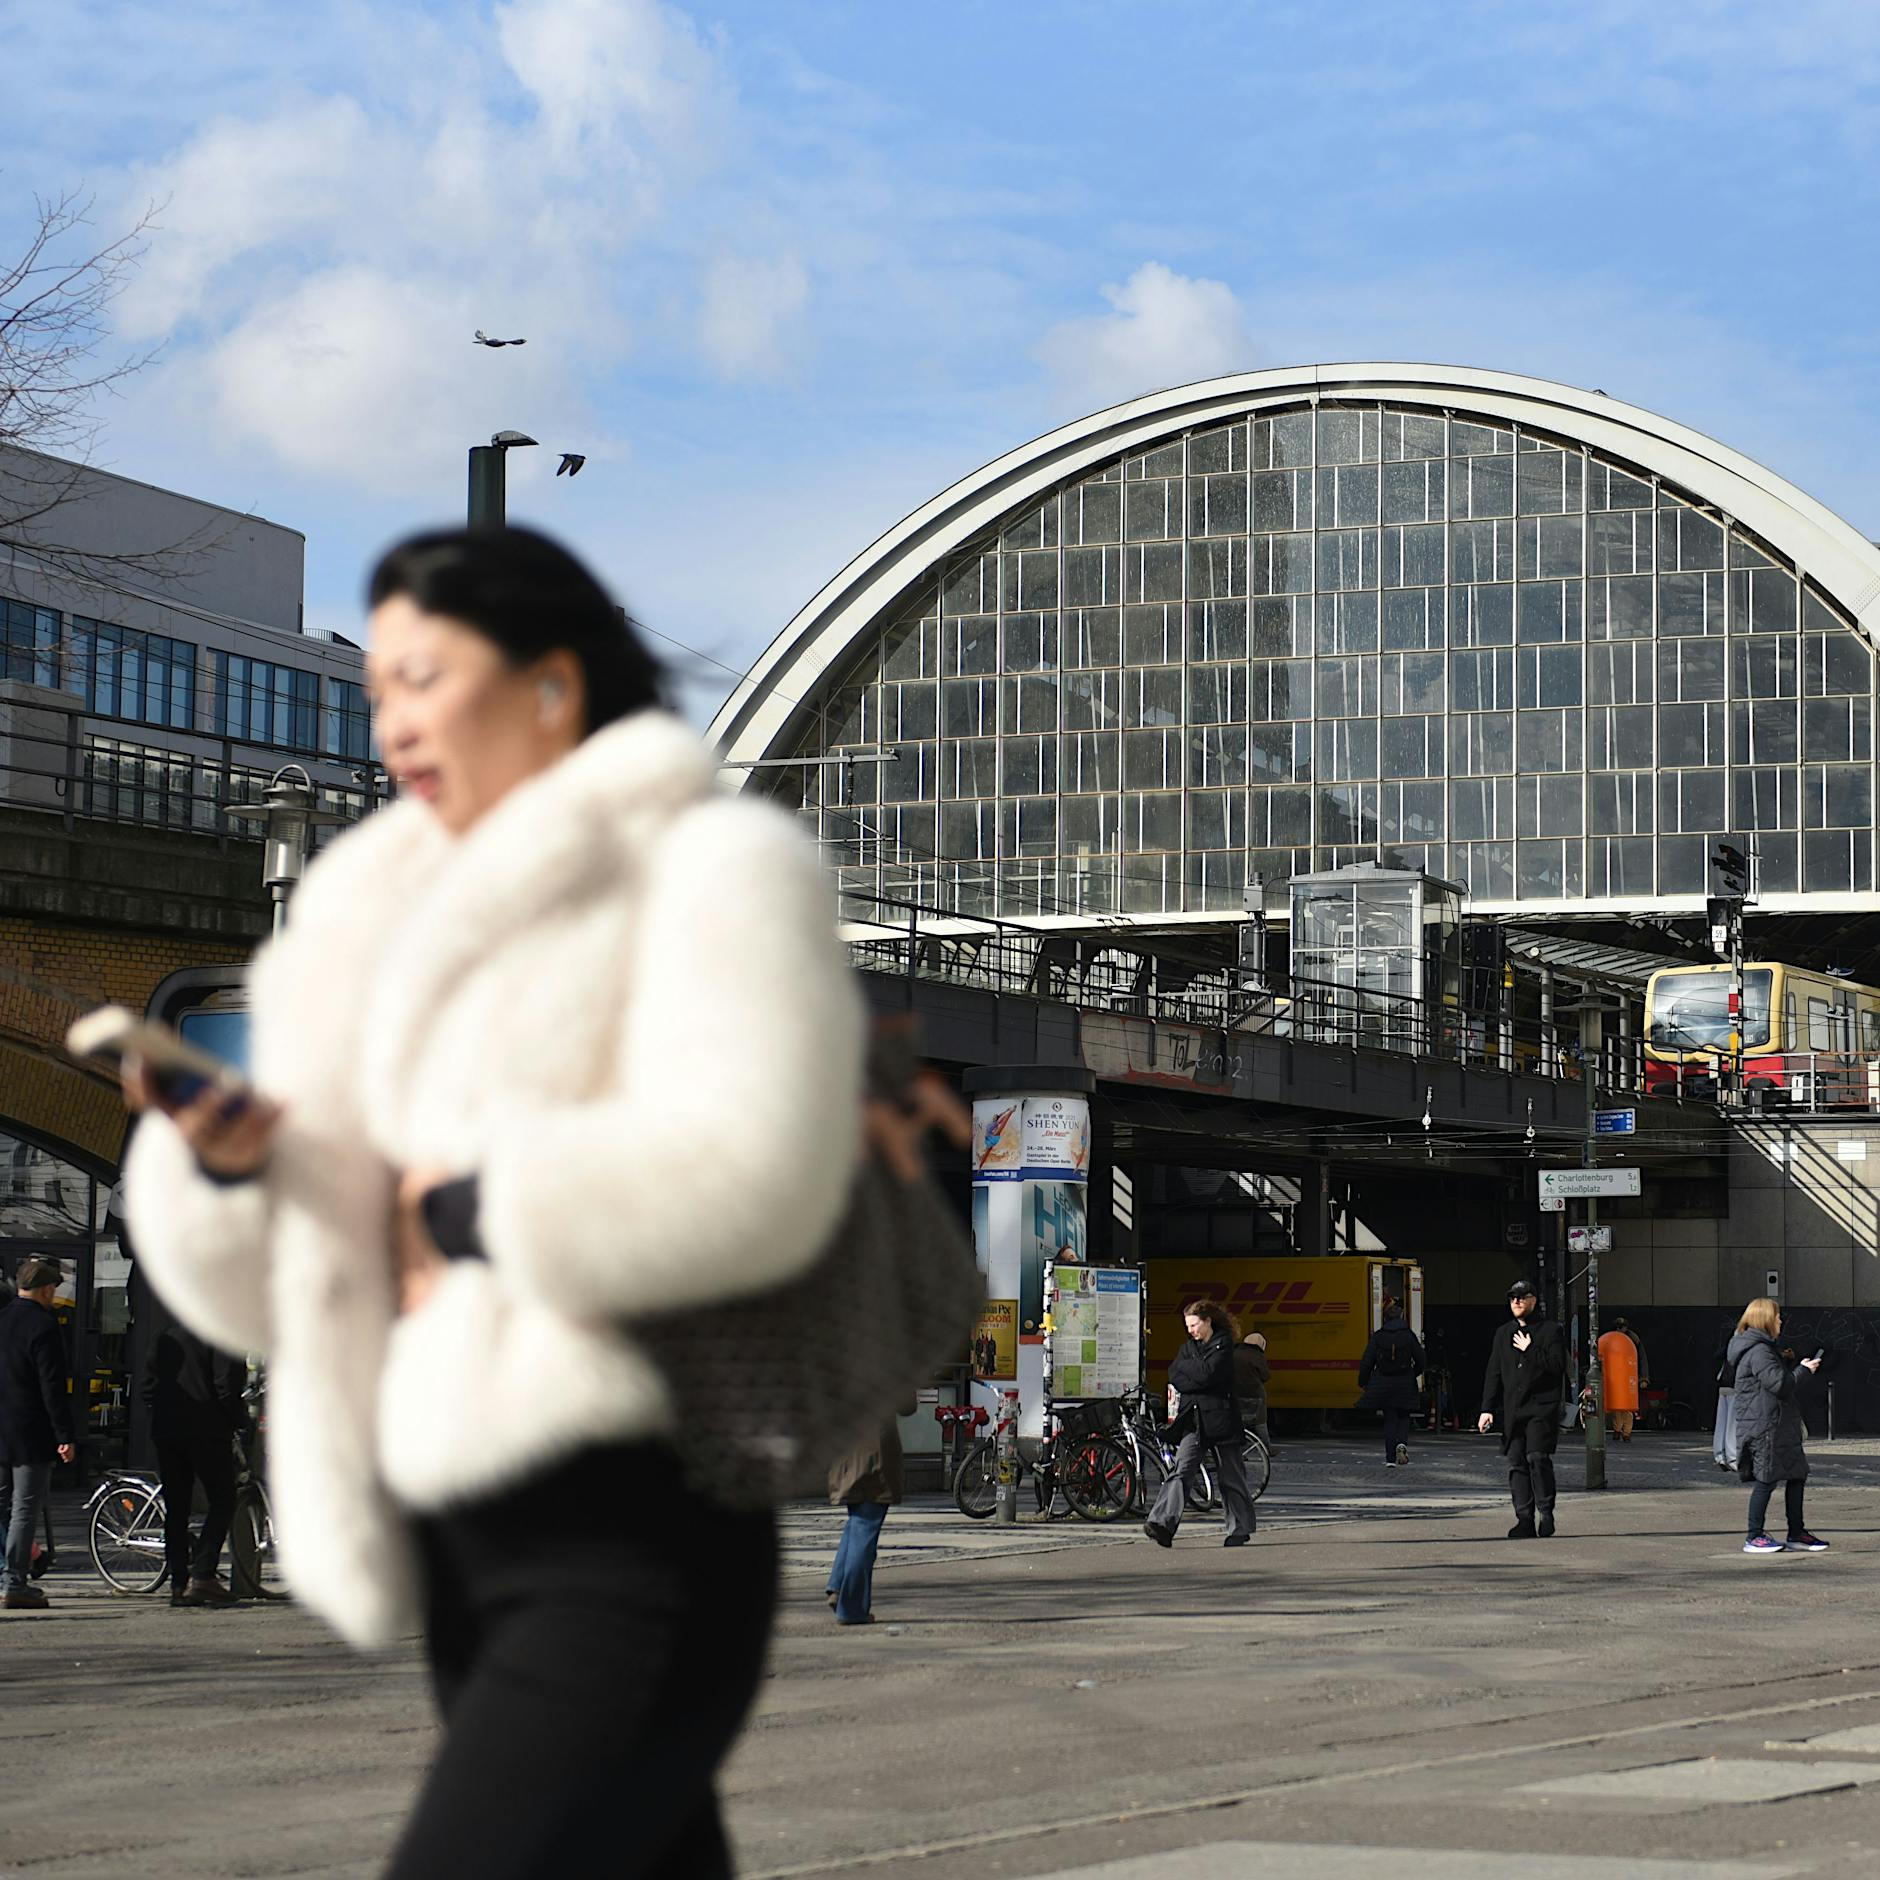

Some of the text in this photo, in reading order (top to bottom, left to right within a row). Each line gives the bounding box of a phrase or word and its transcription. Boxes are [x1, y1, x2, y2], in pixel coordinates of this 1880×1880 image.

[1027, 1120, 1080, 1130] SHEN YUN
[1558, 1174, 1614, 1183] Charlottenburg
[1558, 1185, 1601, 1194] Schloßplatz
[1172, 1282, 1320, 1314] DHL
[979, 1314, 1011, 1323] LOOM
